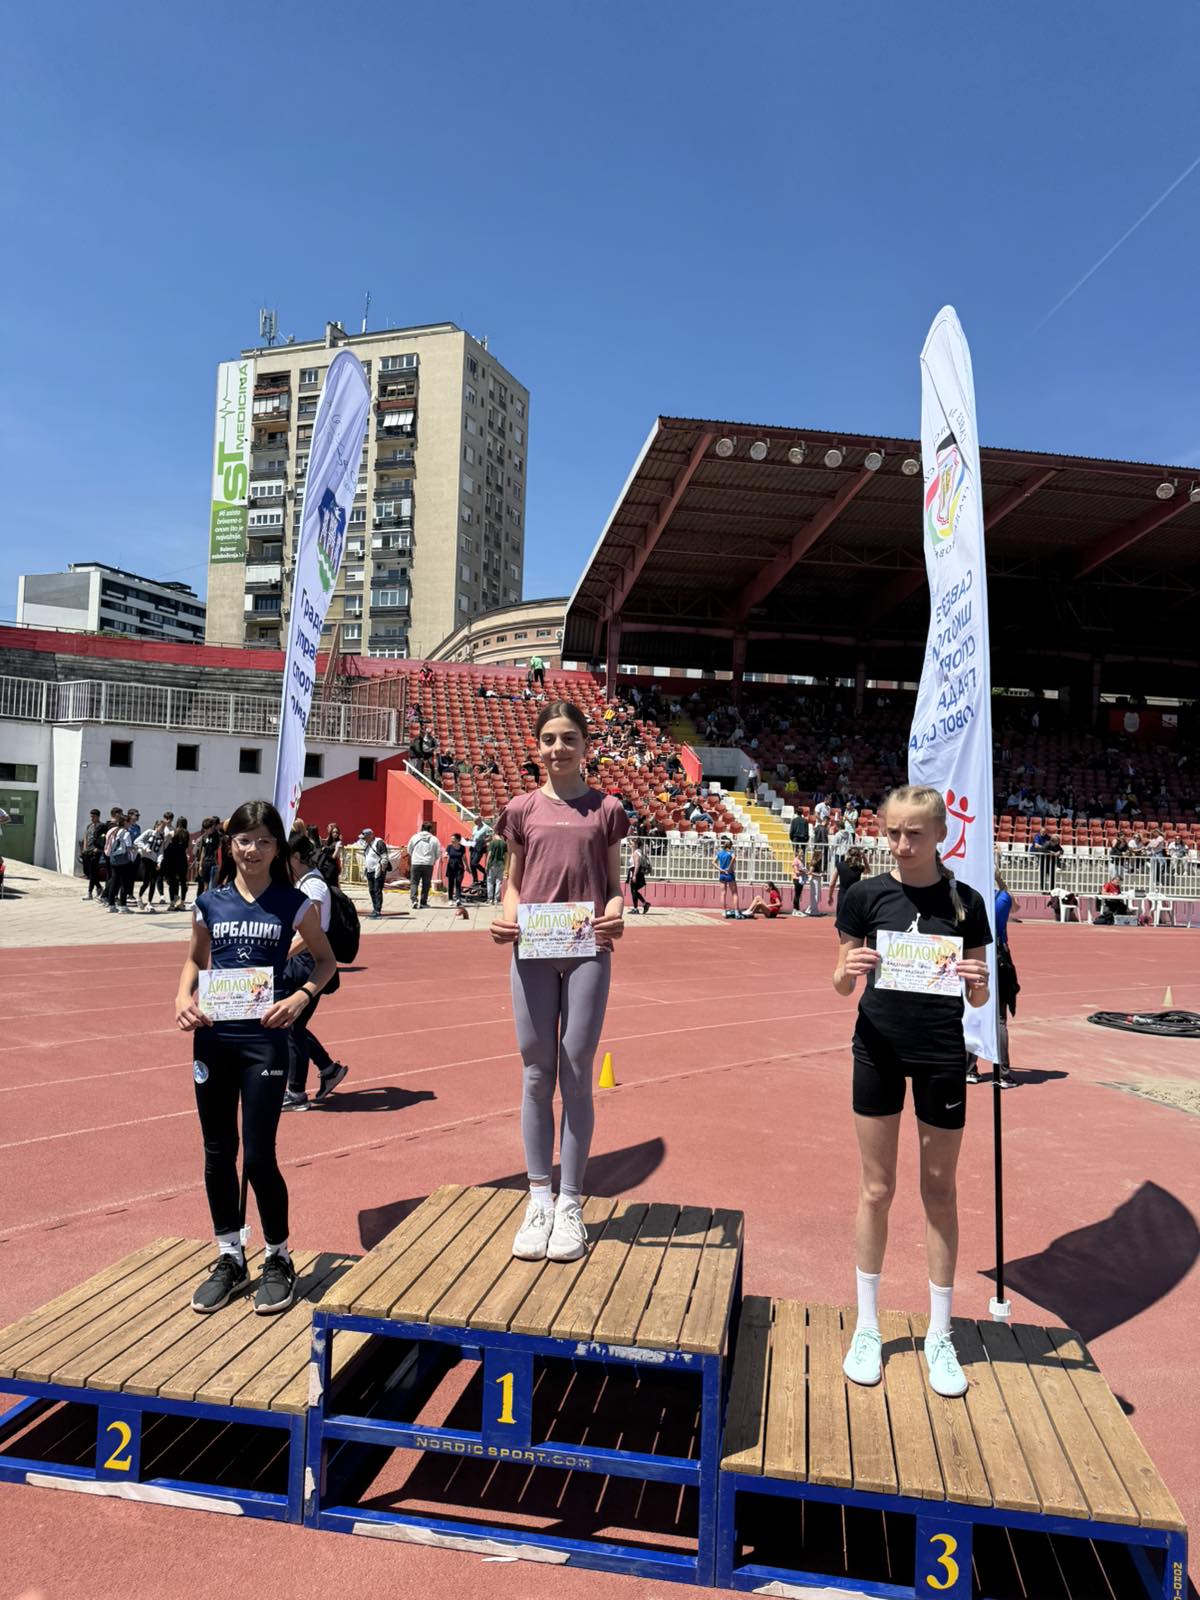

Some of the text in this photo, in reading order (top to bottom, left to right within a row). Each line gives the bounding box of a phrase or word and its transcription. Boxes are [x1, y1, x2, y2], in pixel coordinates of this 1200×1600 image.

[217, 363, 248, 501] ST MEDICINA
[296, 624, 318, 663] упра
[496, 1372, 517, 1424] 1
[104, 1421, 132, 1471] 2
[926, 1533, 959, 1590] 3
